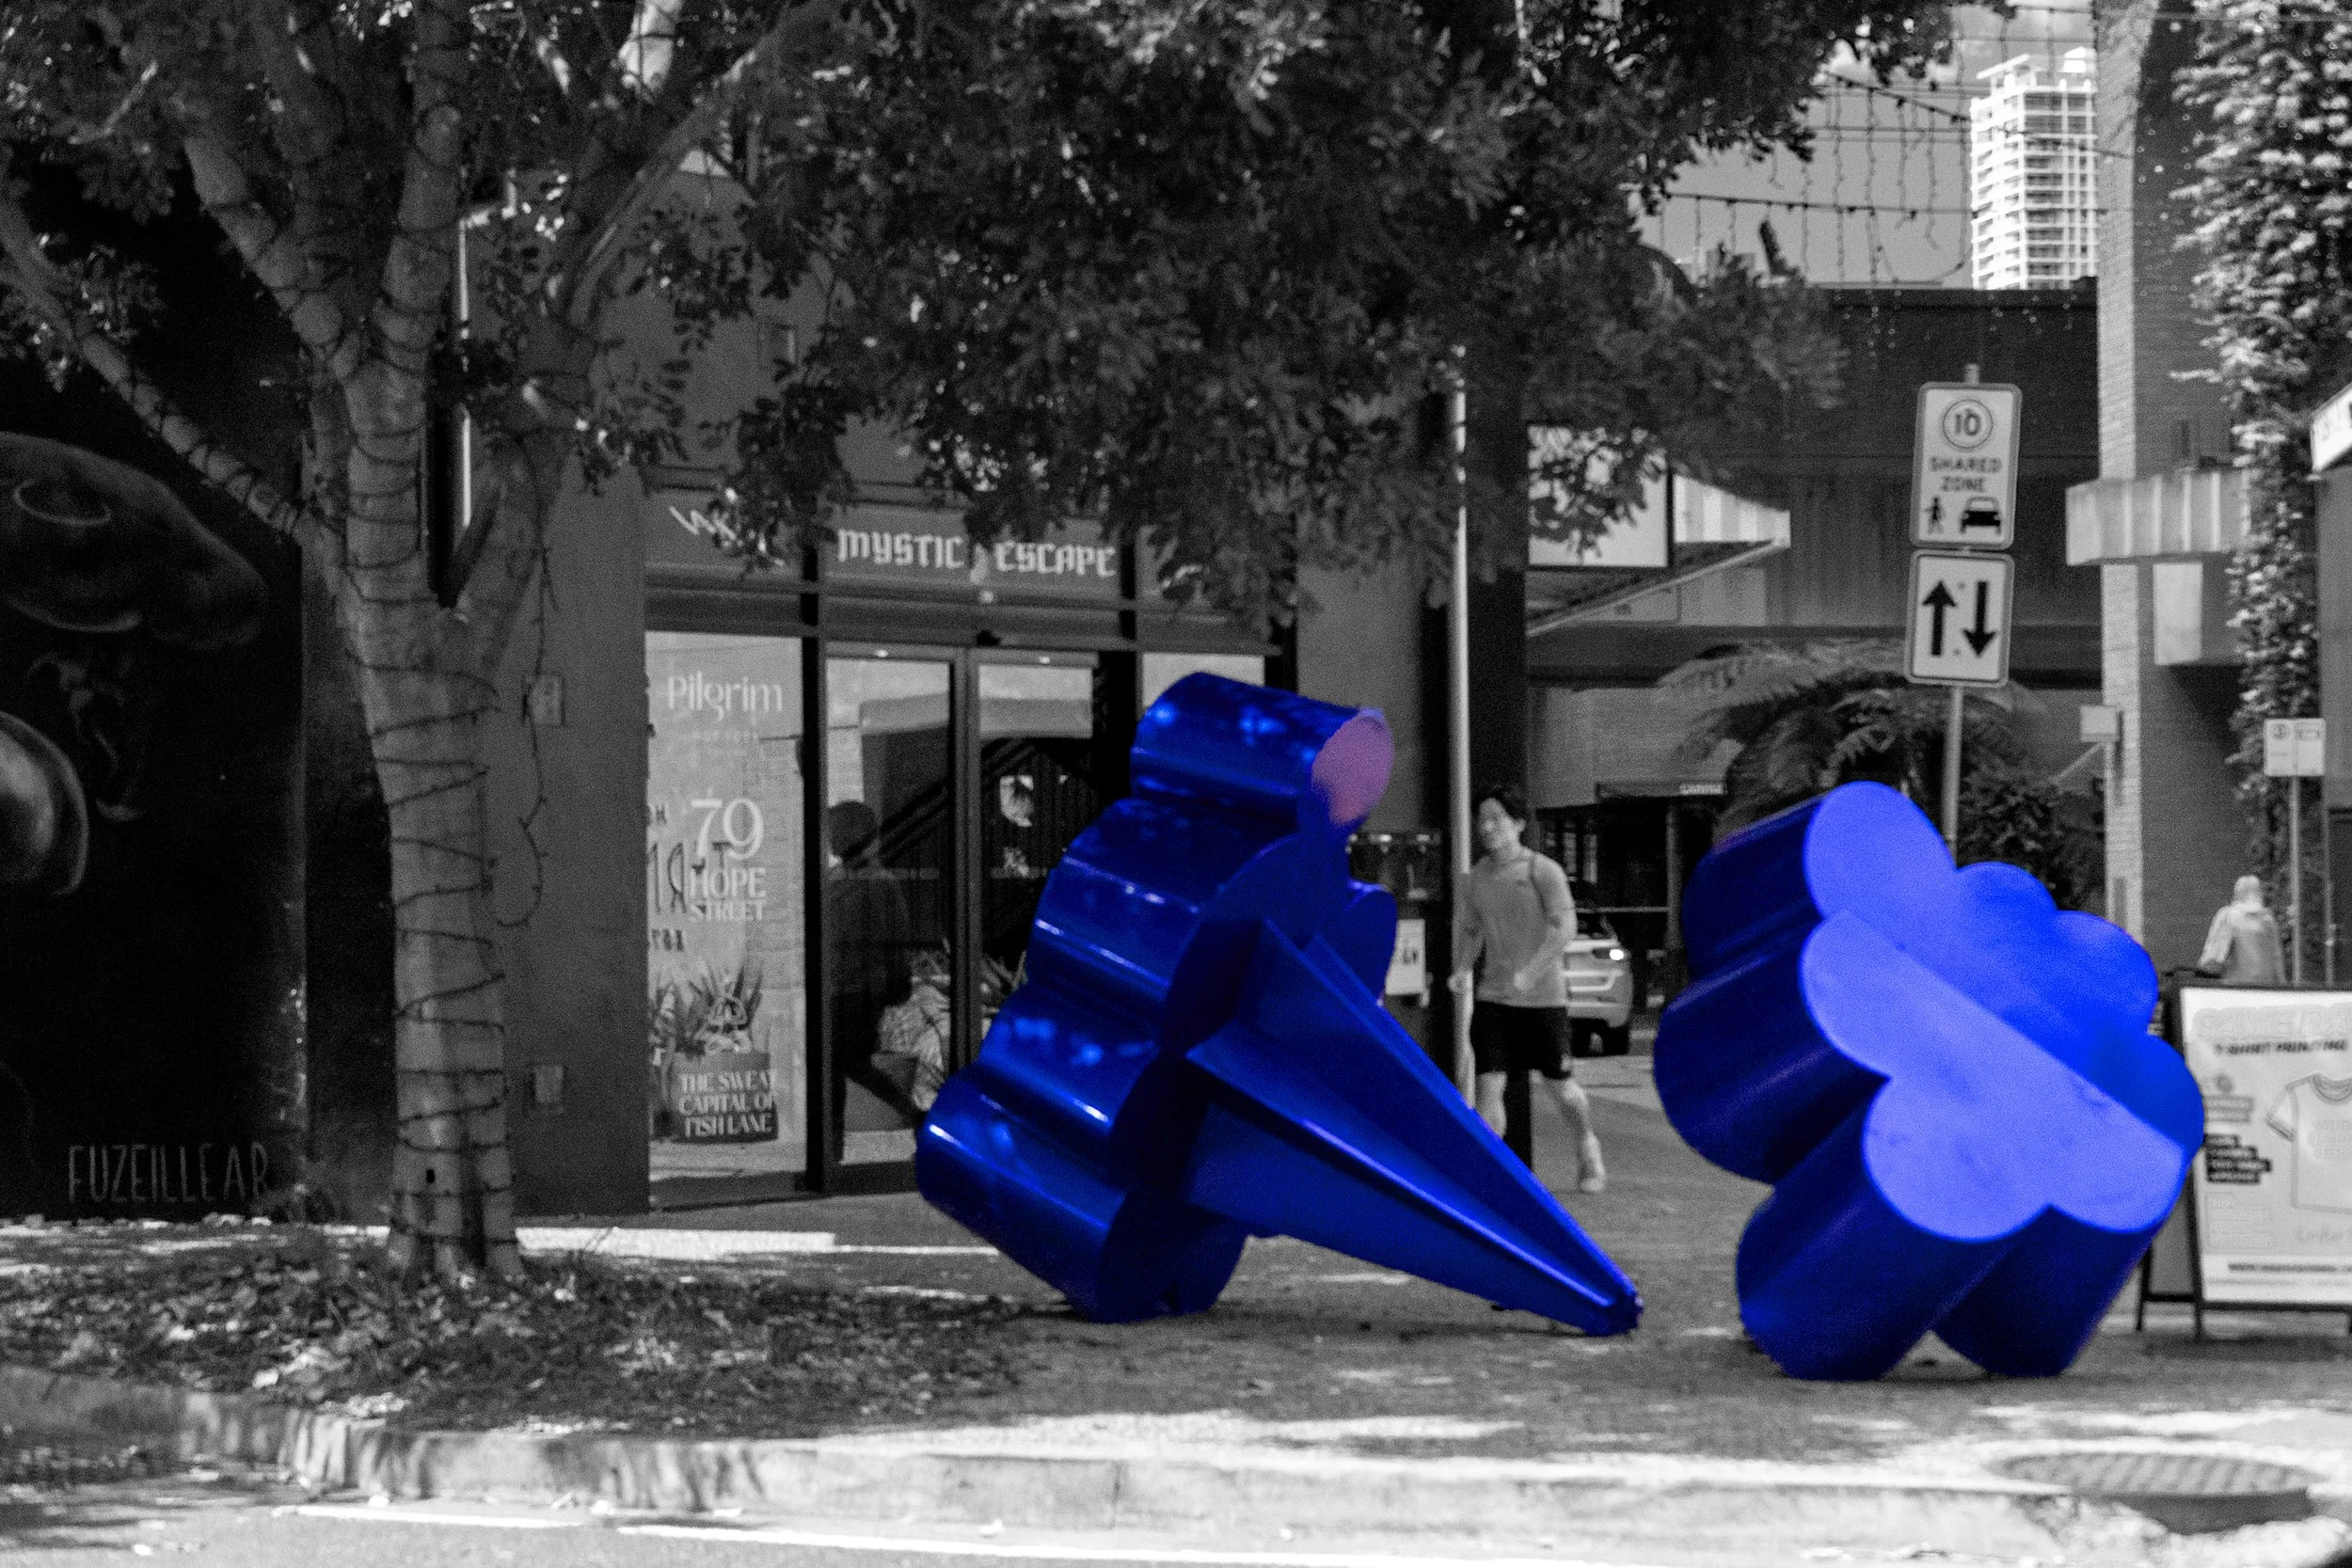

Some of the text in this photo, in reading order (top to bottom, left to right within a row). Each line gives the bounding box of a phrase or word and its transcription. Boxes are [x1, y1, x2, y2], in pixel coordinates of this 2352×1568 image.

[1954, 411, 1981, 436] 10
[1931, 456, 2003, 473] SHARED
[1942, 477, 1985, 492] ZONE
[993, 542, 1117, 578] ESCAPE
[666, 670, 783, 721] Pilgrim
[691, 798, 764, 860] 79
[690, 866, 767, 898] HOPE
[689, 900, 765, 924] STREET
[679, 1073, 714, 1093] THE
[677, 1092, 751, 1116] CAPITAL
